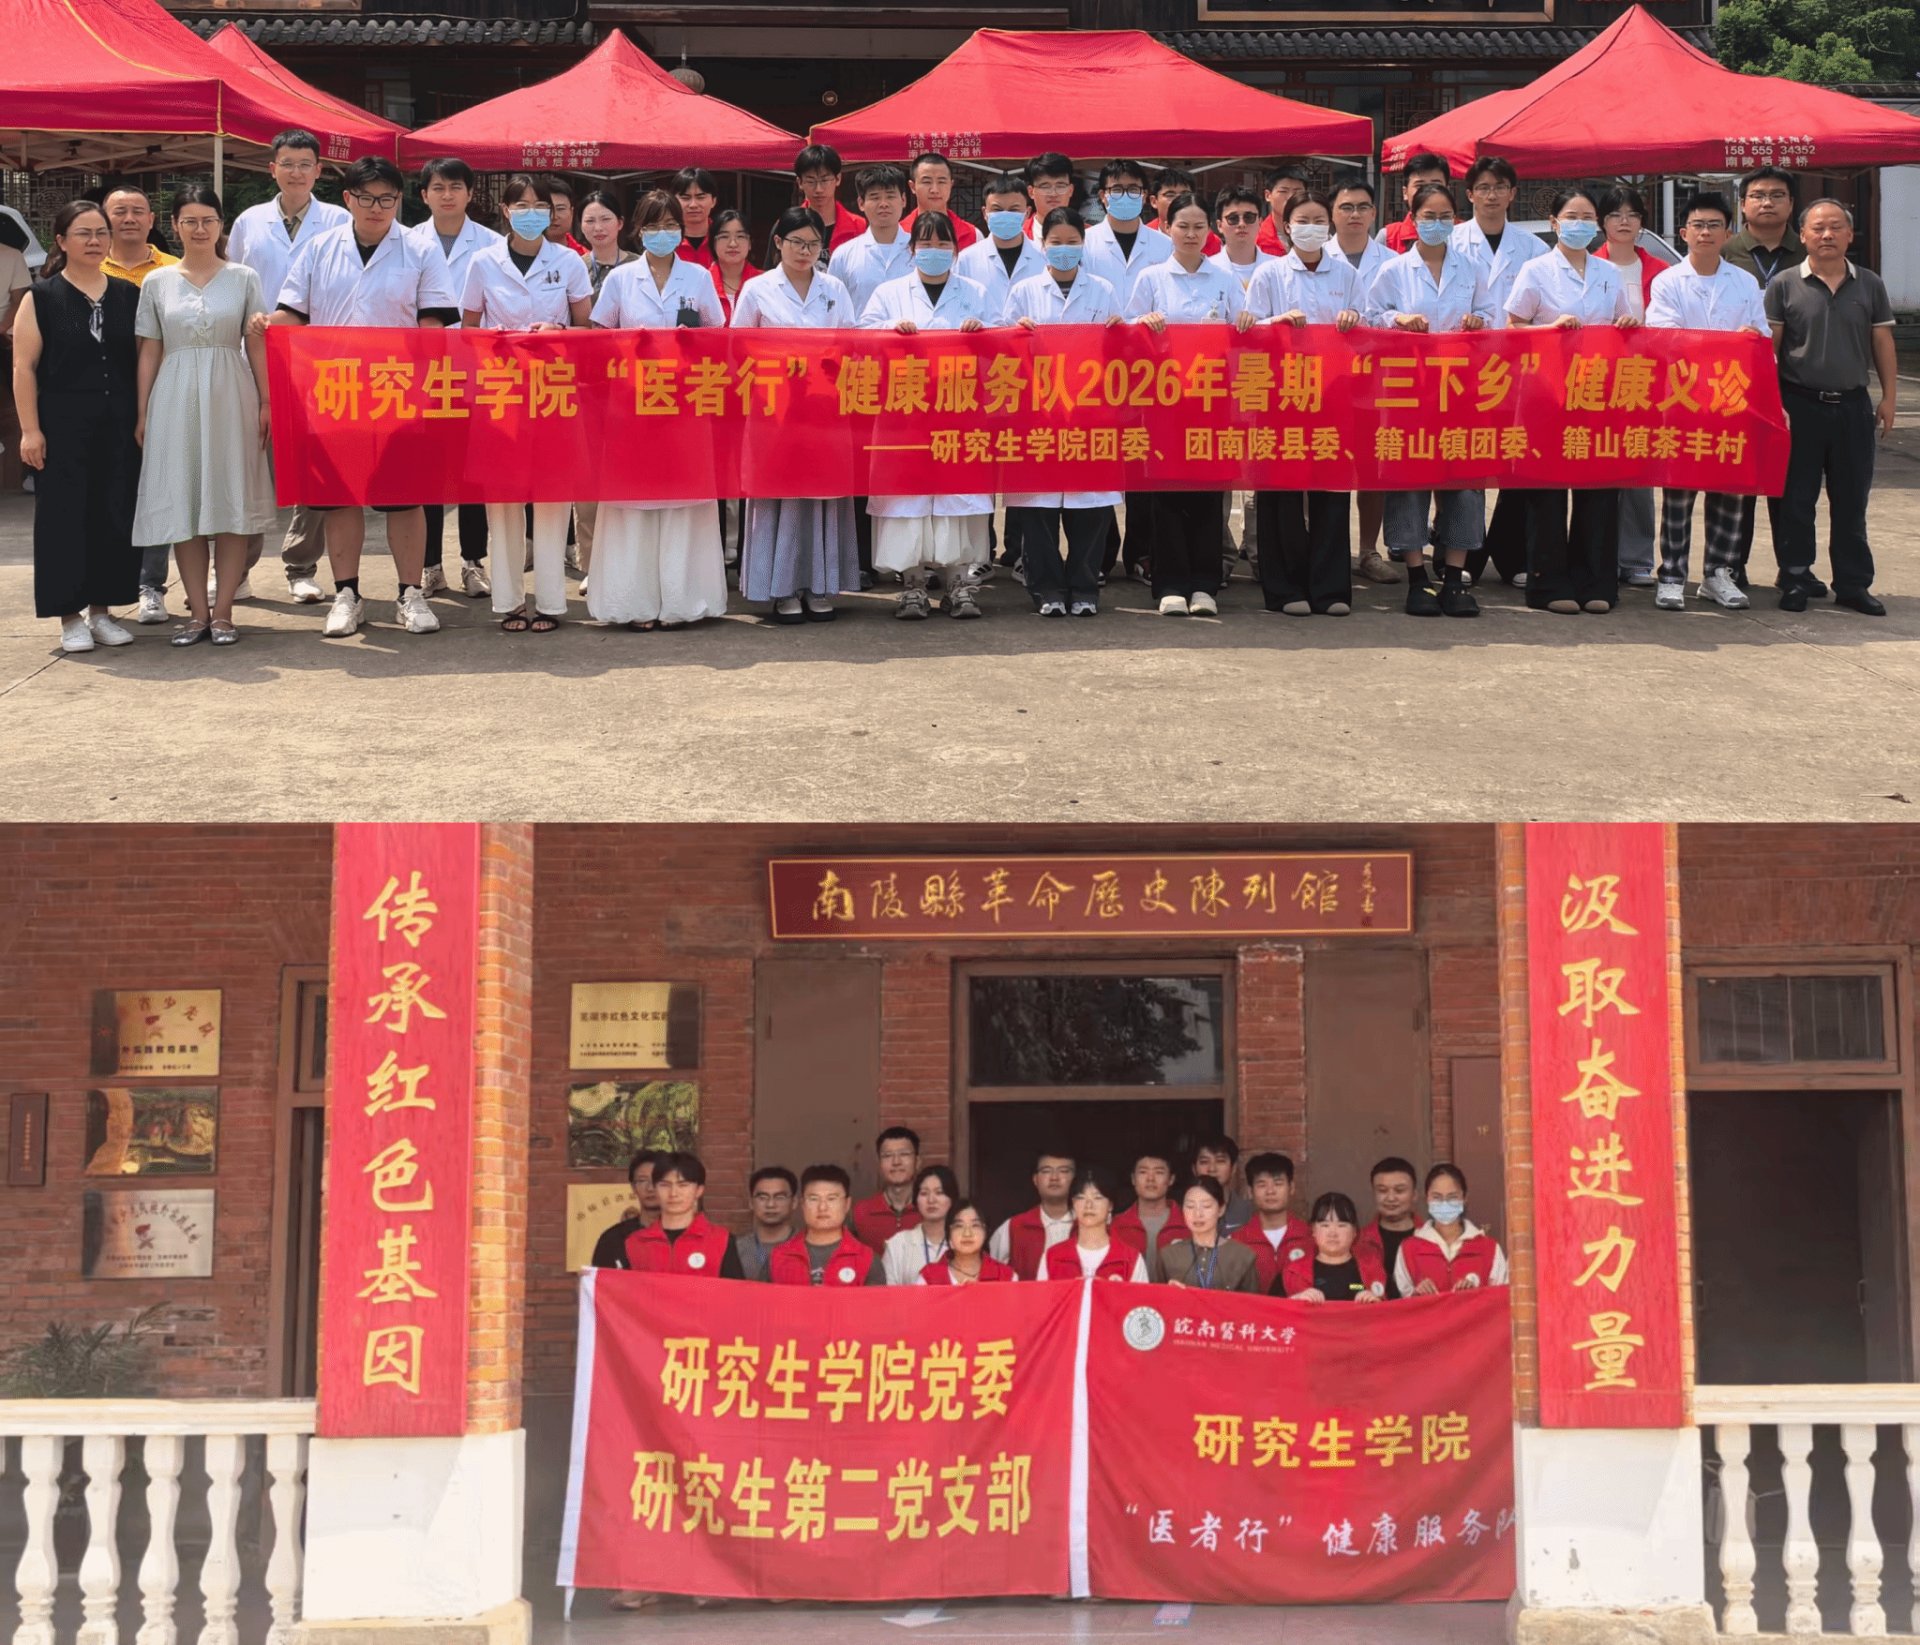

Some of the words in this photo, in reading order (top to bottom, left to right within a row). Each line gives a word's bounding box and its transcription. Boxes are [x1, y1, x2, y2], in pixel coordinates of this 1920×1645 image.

[522, 149, 539, 157] 158
[545, 149, 563, 157] 555
[570, 149, 600, 157] 34352
[908, 141, 924, 149] 158
[932, 140, 949, 148] 555
[953, 139, 981, 147] 34352
[1725, 146, 1744, 155] 158
[1752, 146, 1773, 155] 555
[1780, 145, 1815, 155] 34352
[1725, 156, 1808, 167] 南陵后港桥
[356, 871, 446, 1395] 传承红色基因
[1558, 873, 1644, 1391] 汲取奋进力量
[660, 1337, 1017, 1422] 研究生学院党委
[1193, 1411, 1471, 1468] 研究生学院
[630, 1451, 1032, 1542] 研究生第二党支部
